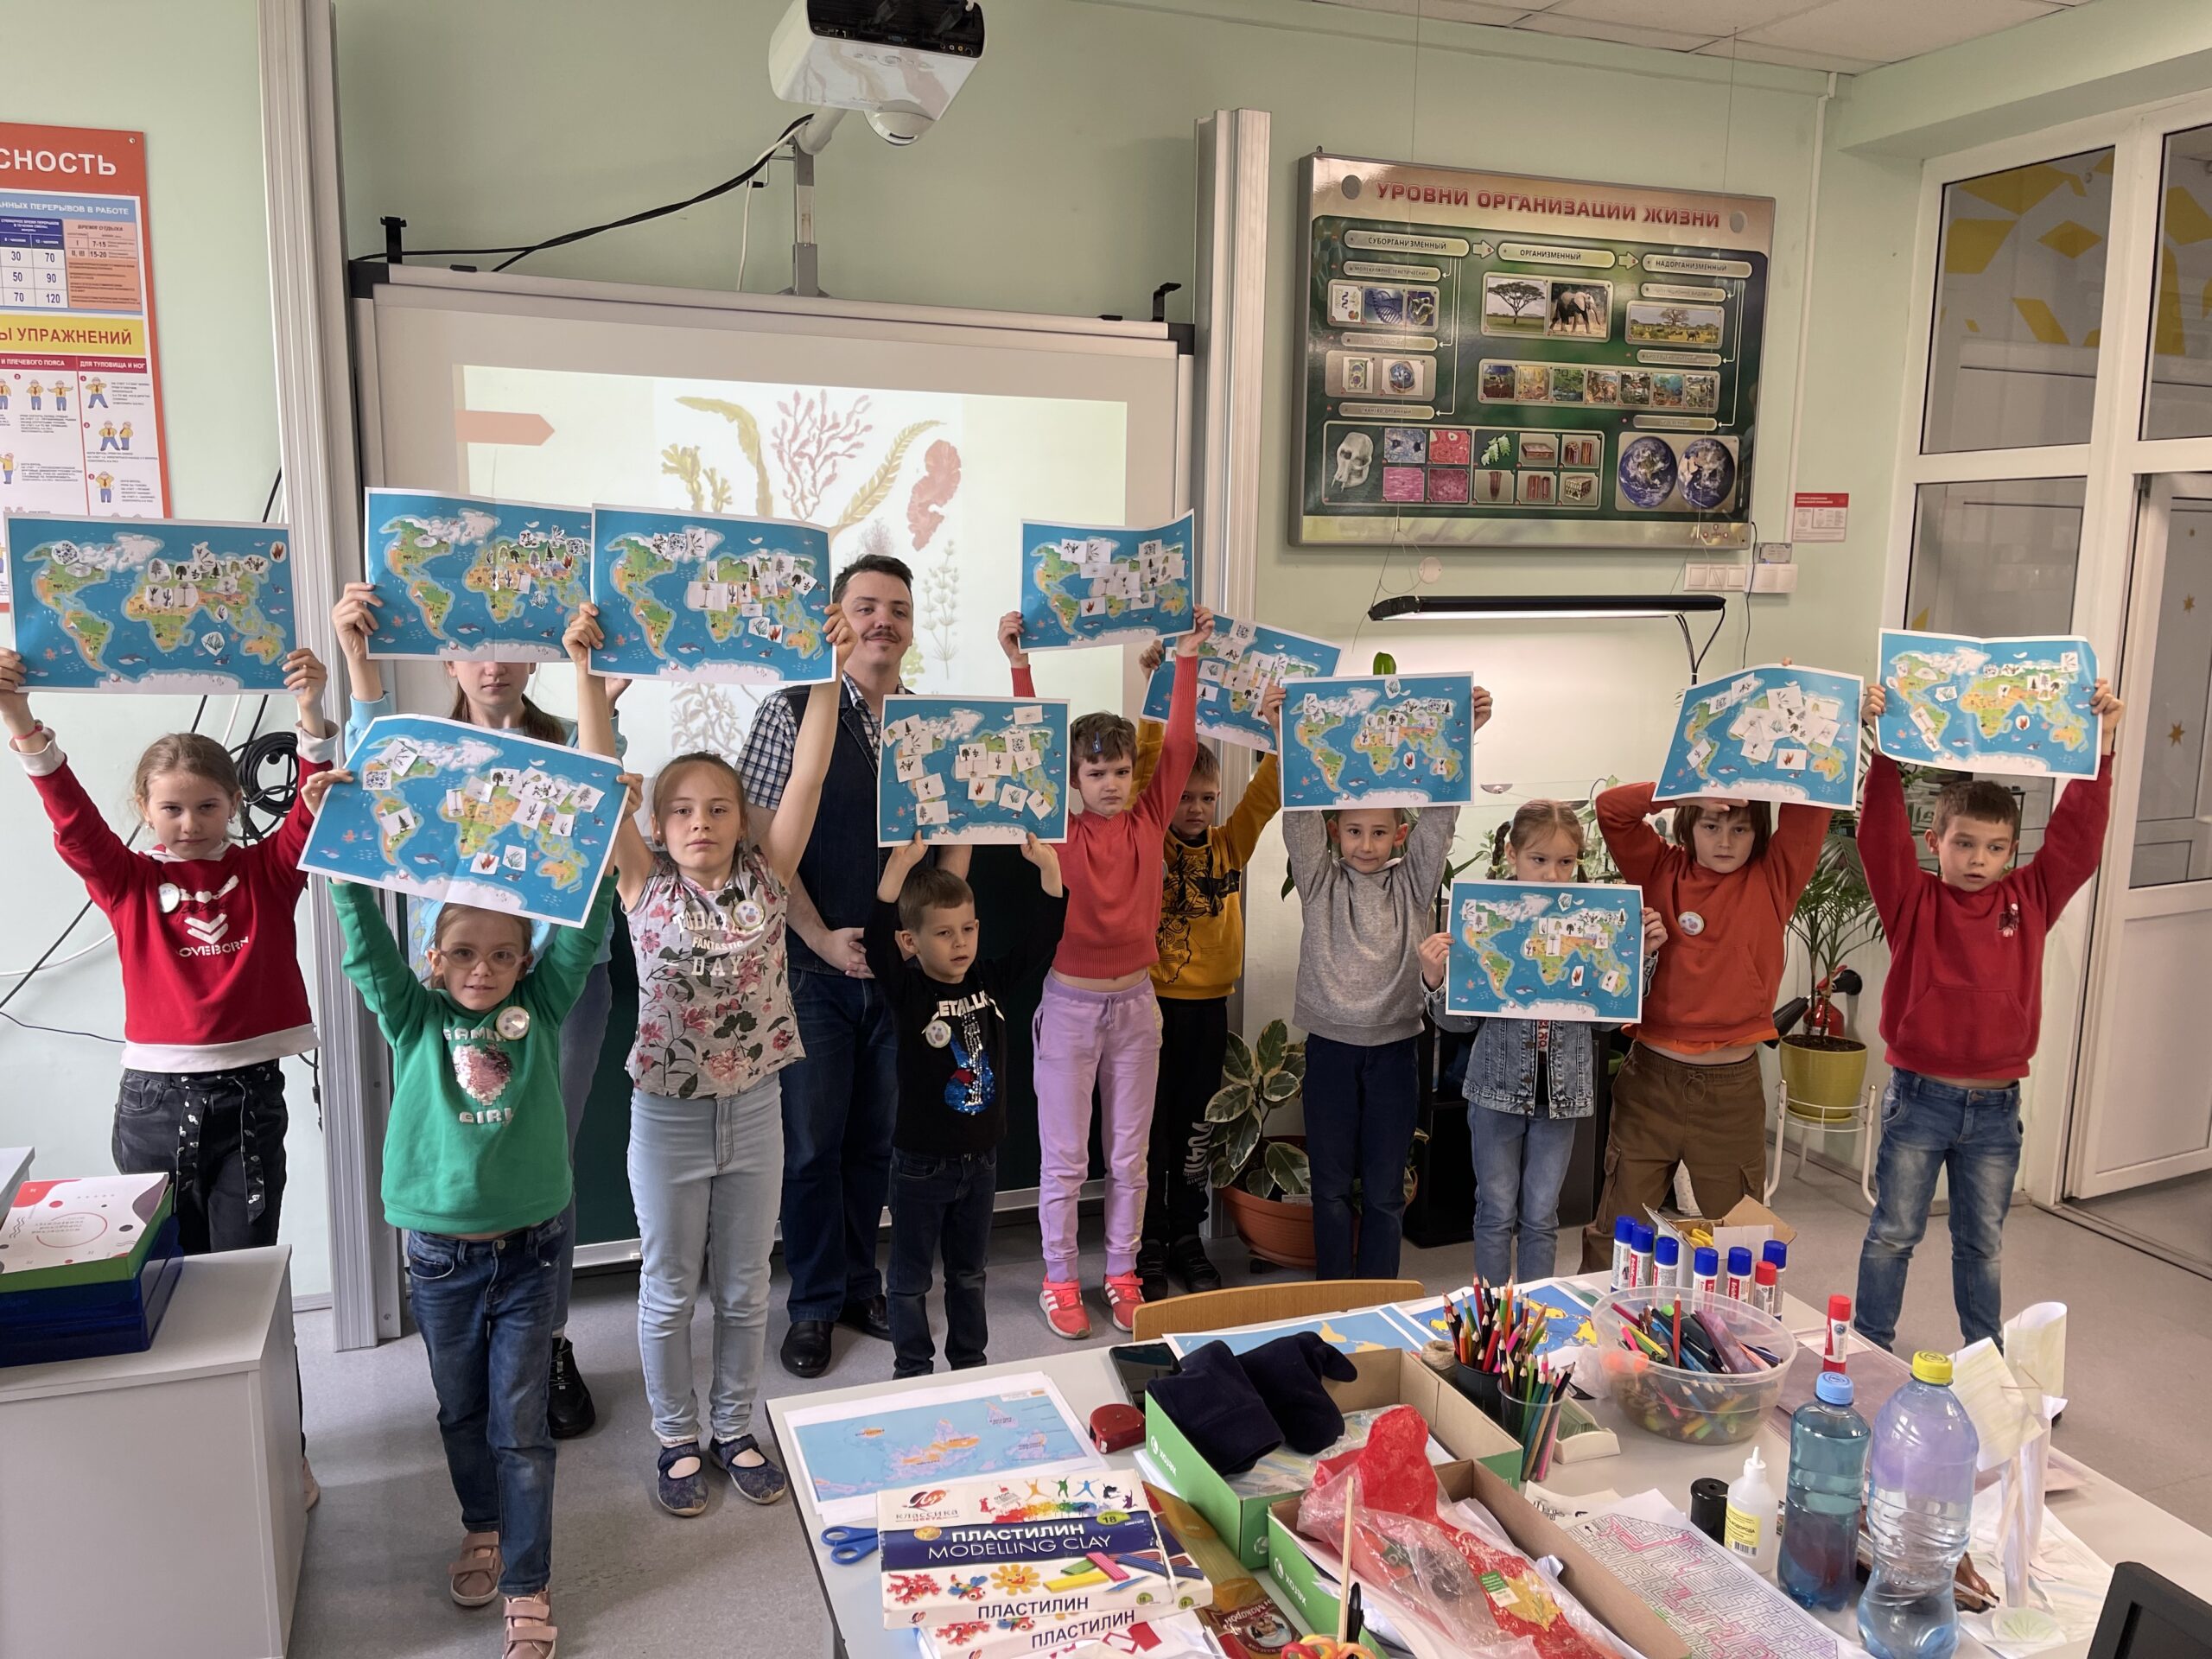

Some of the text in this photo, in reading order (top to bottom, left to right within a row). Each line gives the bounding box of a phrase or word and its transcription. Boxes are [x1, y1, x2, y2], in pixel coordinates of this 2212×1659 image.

[31, 203, 85, 213] ПЕРЕРЫВОВ
[1376, 181, 1719, 227] УРОВНИ ОРГАНИЗАЦИИ ЖИЗНИ
[1368, 237, 1446, 250] СУБОРГАНИЗМЕННЫЙ
[11, 251, 21, 261] 30
[45, 253, 55, 263] 70
[1520, 249, 1581, 261] ОРГАНИЗМЕННЫЙ
[1656, 260, 1727, 271] НАДОРГАНИЗМЕННЫЙ
[13, 271, 22, 282] 50
[47, 273, 56, 283] 90
[14, 292, 24, 302] 70
[46, 294, 60, 303] 120
[17, 328, 132, 345] УПРАЖНЕНИЙ
[672, 911, 728, 933] TODAY
[177, 936, 249, 957] OVEBORN
[692, 937, 744, 950] FANTASTIC
[691, 955, 744, 976] DAY
[460, 1107, 513, 1127] GIRL
[1159, 1450, 1177, 1477] xerox
[952, 1523, 1085, 1543] ПЛАСТИЛИН
[929, 1535, 1111, 1560] MODELLING CLAY
[1285, 1573, 1306, 1607] xerox
[978, 1597, 1089, 1620] ПЛАСТИЛИН
[1032, 1610, 1135, 1649] ПЛАСТИЛИН
